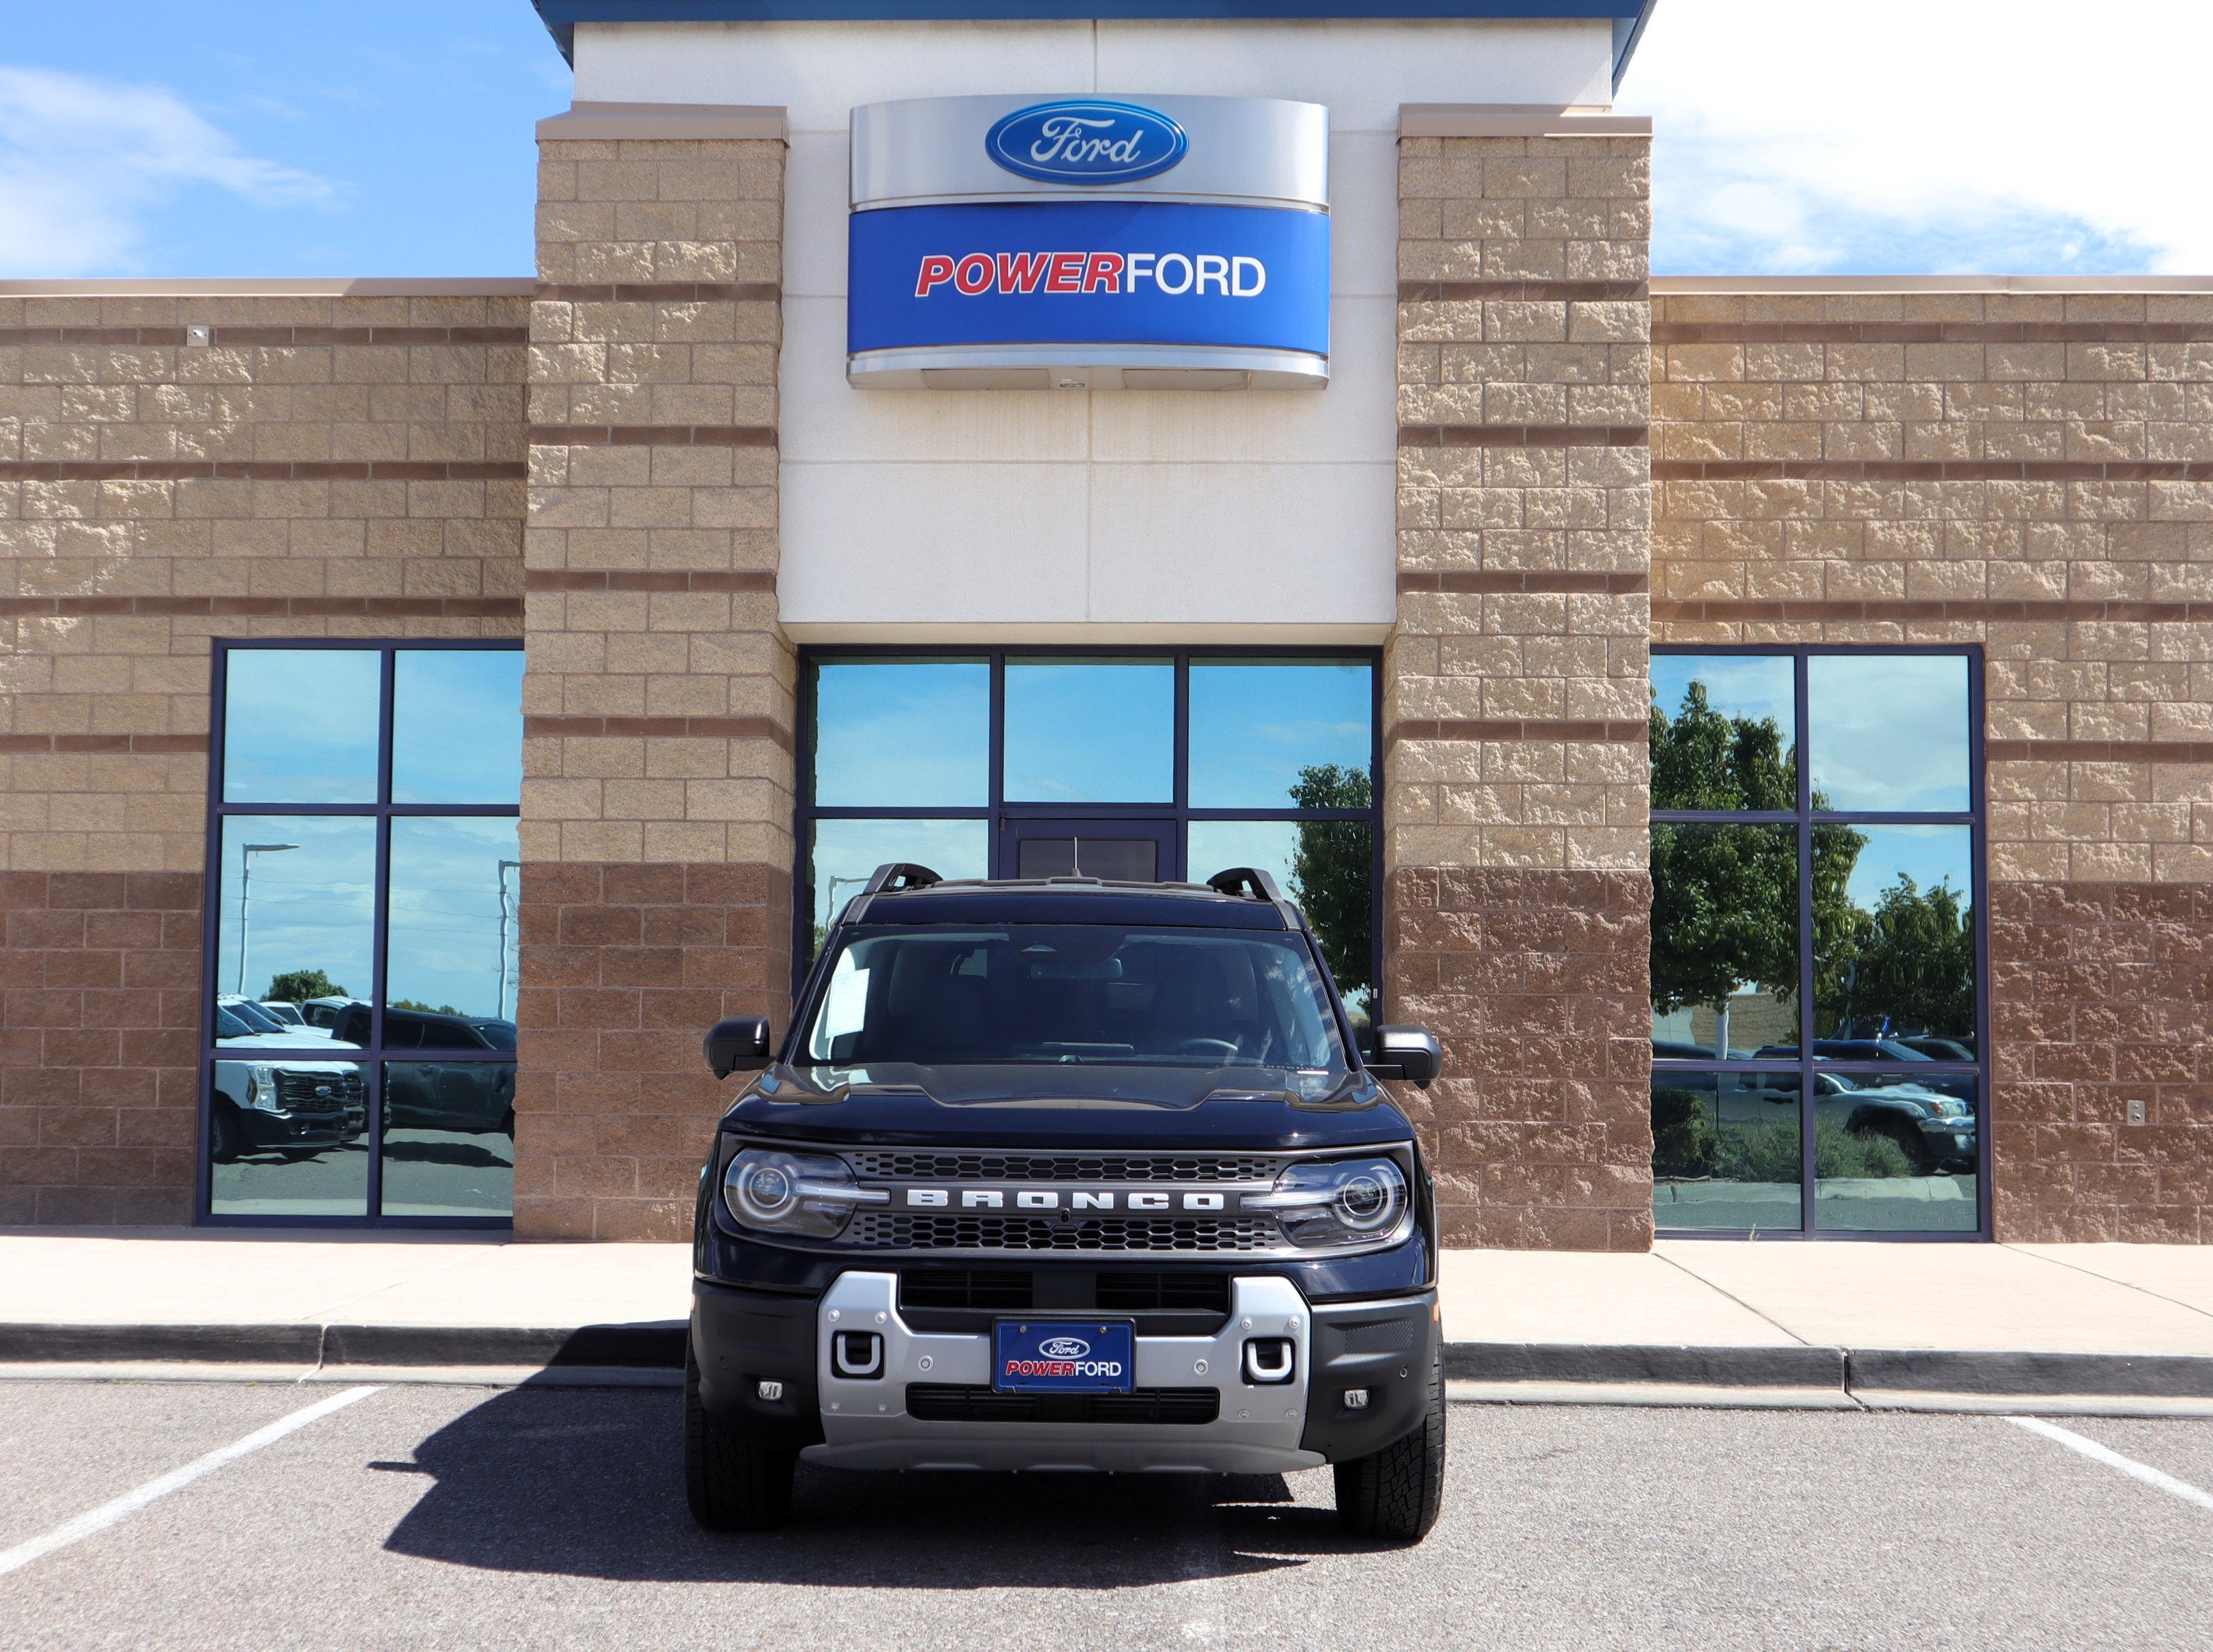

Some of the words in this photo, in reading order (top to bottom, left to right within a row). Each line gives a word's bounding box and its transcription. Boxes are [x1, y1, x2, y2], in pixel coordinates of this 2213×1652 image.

[1030, 116, 1144, 163] Ford
[915, 252, 1266, 297] POWERFORD
[907, 1189, 1224, 1210] BRONCO
[1049, 1341, 1080, 1355] Ford
[1005, 1360, 1122, 1377] POWERFORD
